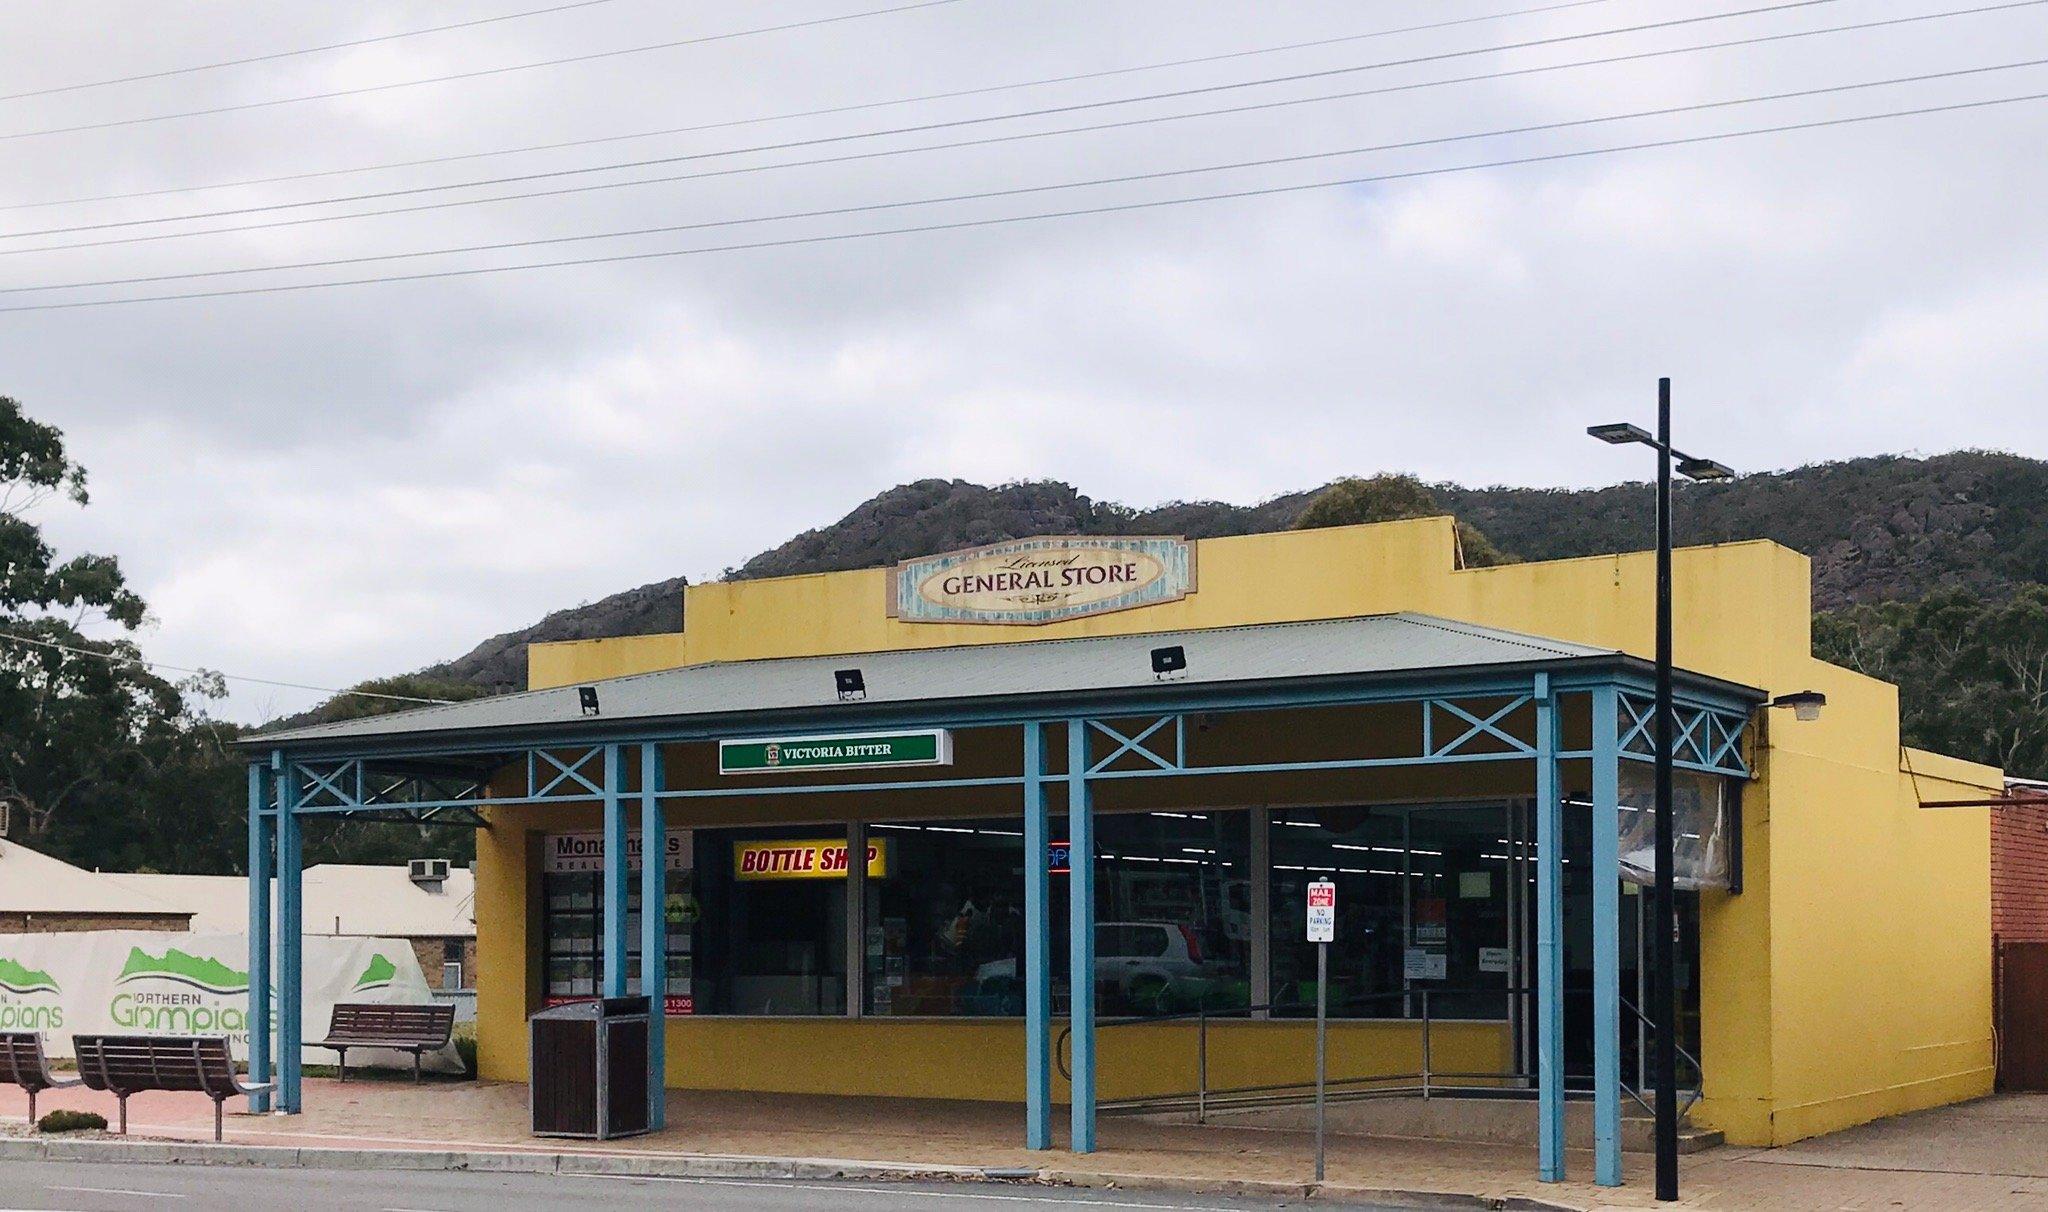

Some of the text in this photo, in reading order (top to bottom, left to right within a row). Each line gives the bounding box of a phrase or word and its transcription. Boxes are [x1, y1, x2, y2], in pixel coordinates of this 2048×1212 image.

[995, 554, 1080, 570] Licensed
[943, 563, 1137, 595] GENERAL STORE
[783, 746, 843, 760] VICTORIA
[846, 744, 892, 756] BITTER
[557, 861, 598, 870] REAL
[741, 847, 878, 873] BOTTLE SHP
[1311, 889, 1332, 897] MAIL
[1310, 917, 1331, 925] PARKING
[671, 999, 692, 1008] 1300
